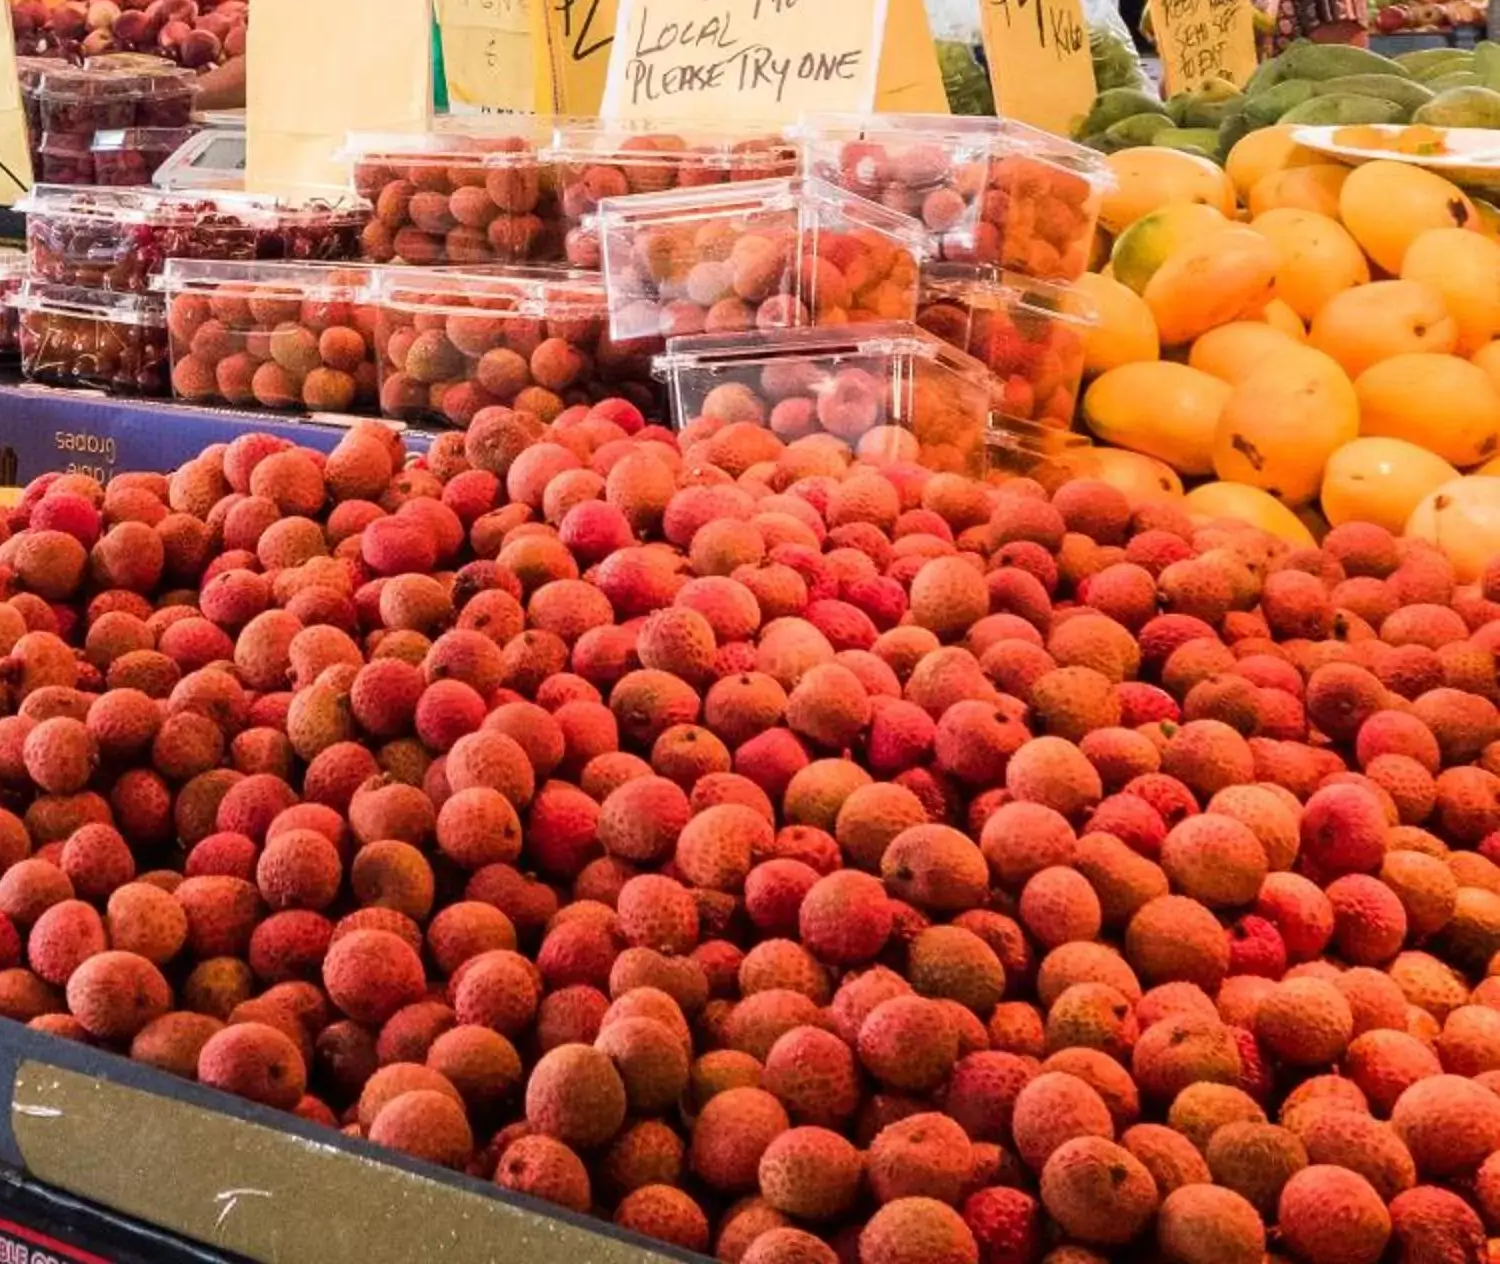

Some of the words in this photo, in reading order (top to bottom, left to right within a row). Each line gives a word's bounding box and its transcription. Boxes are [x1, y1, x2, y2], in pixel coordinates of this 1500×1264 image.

[636, 7, 738, 59] LOCAL
[625, 58, 728, 105] PLEASE
[725, 44, 791, 102] TRY
[798, 50, 862, 84] ONE
[54, 428, 116, 464] Grapes
